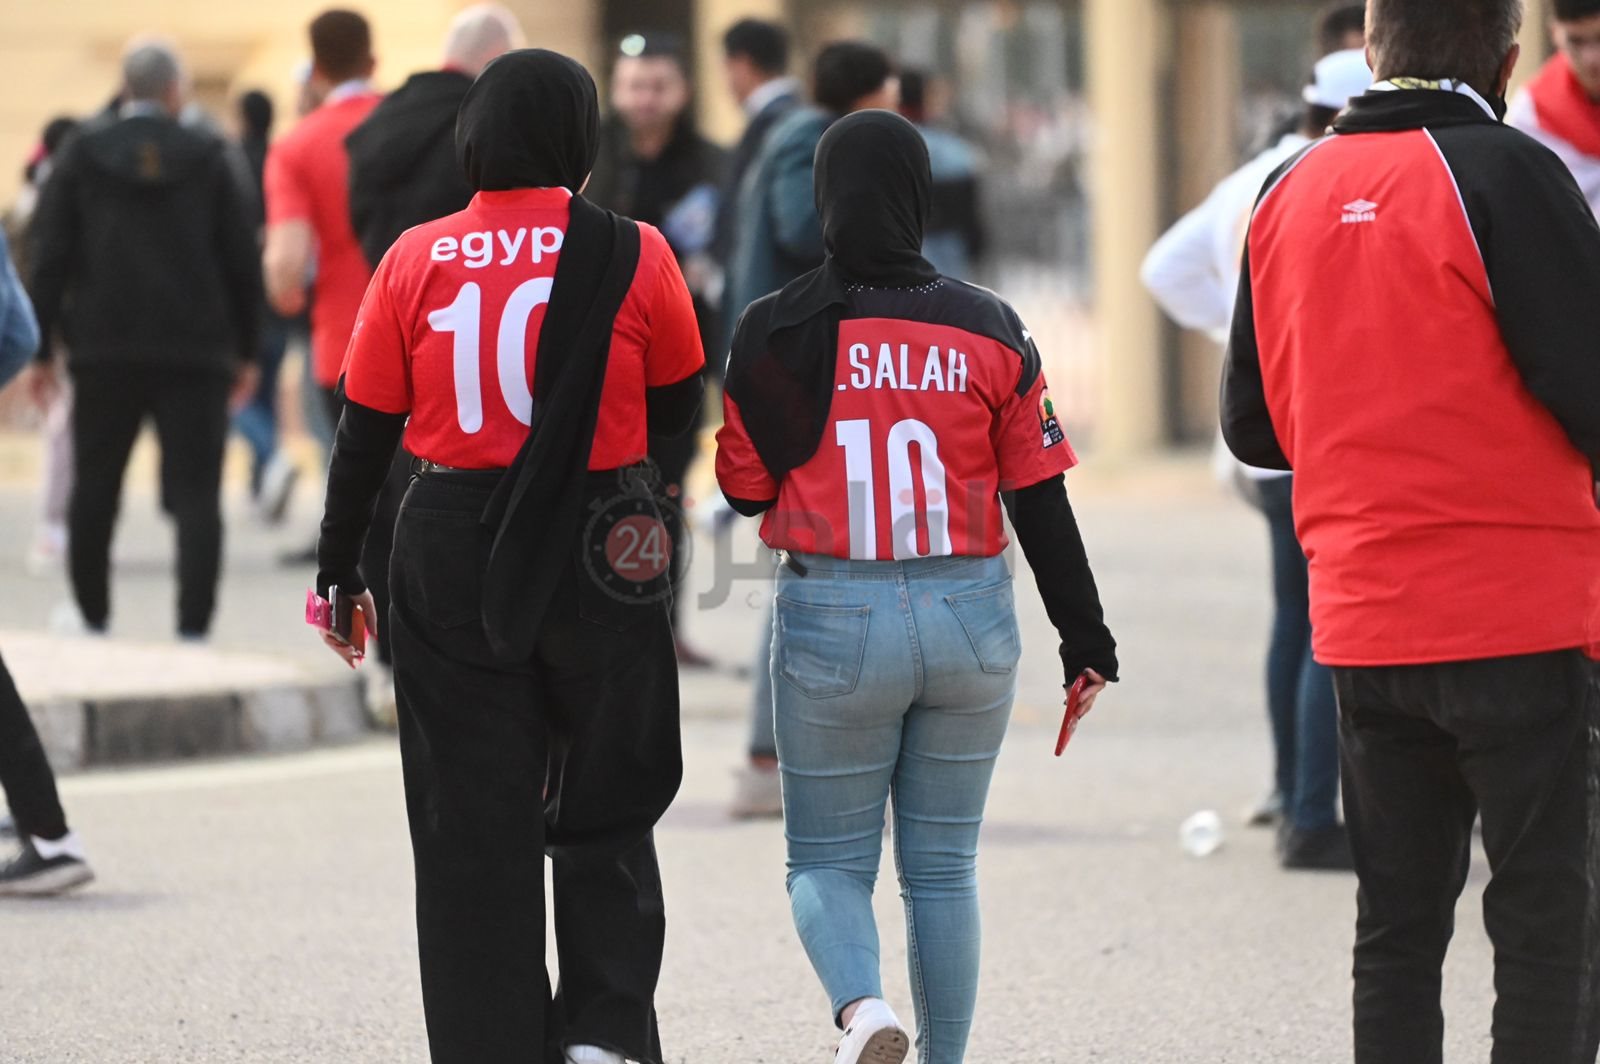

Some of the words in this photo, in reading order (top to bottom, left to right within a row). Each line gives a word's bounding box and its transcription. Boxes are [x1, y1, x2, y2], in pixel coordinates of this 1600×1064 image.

[430, 226, 565, 269] egyp
[837, 342, 968, 393] .SALAH
[835, 418, 952, 561] 10
